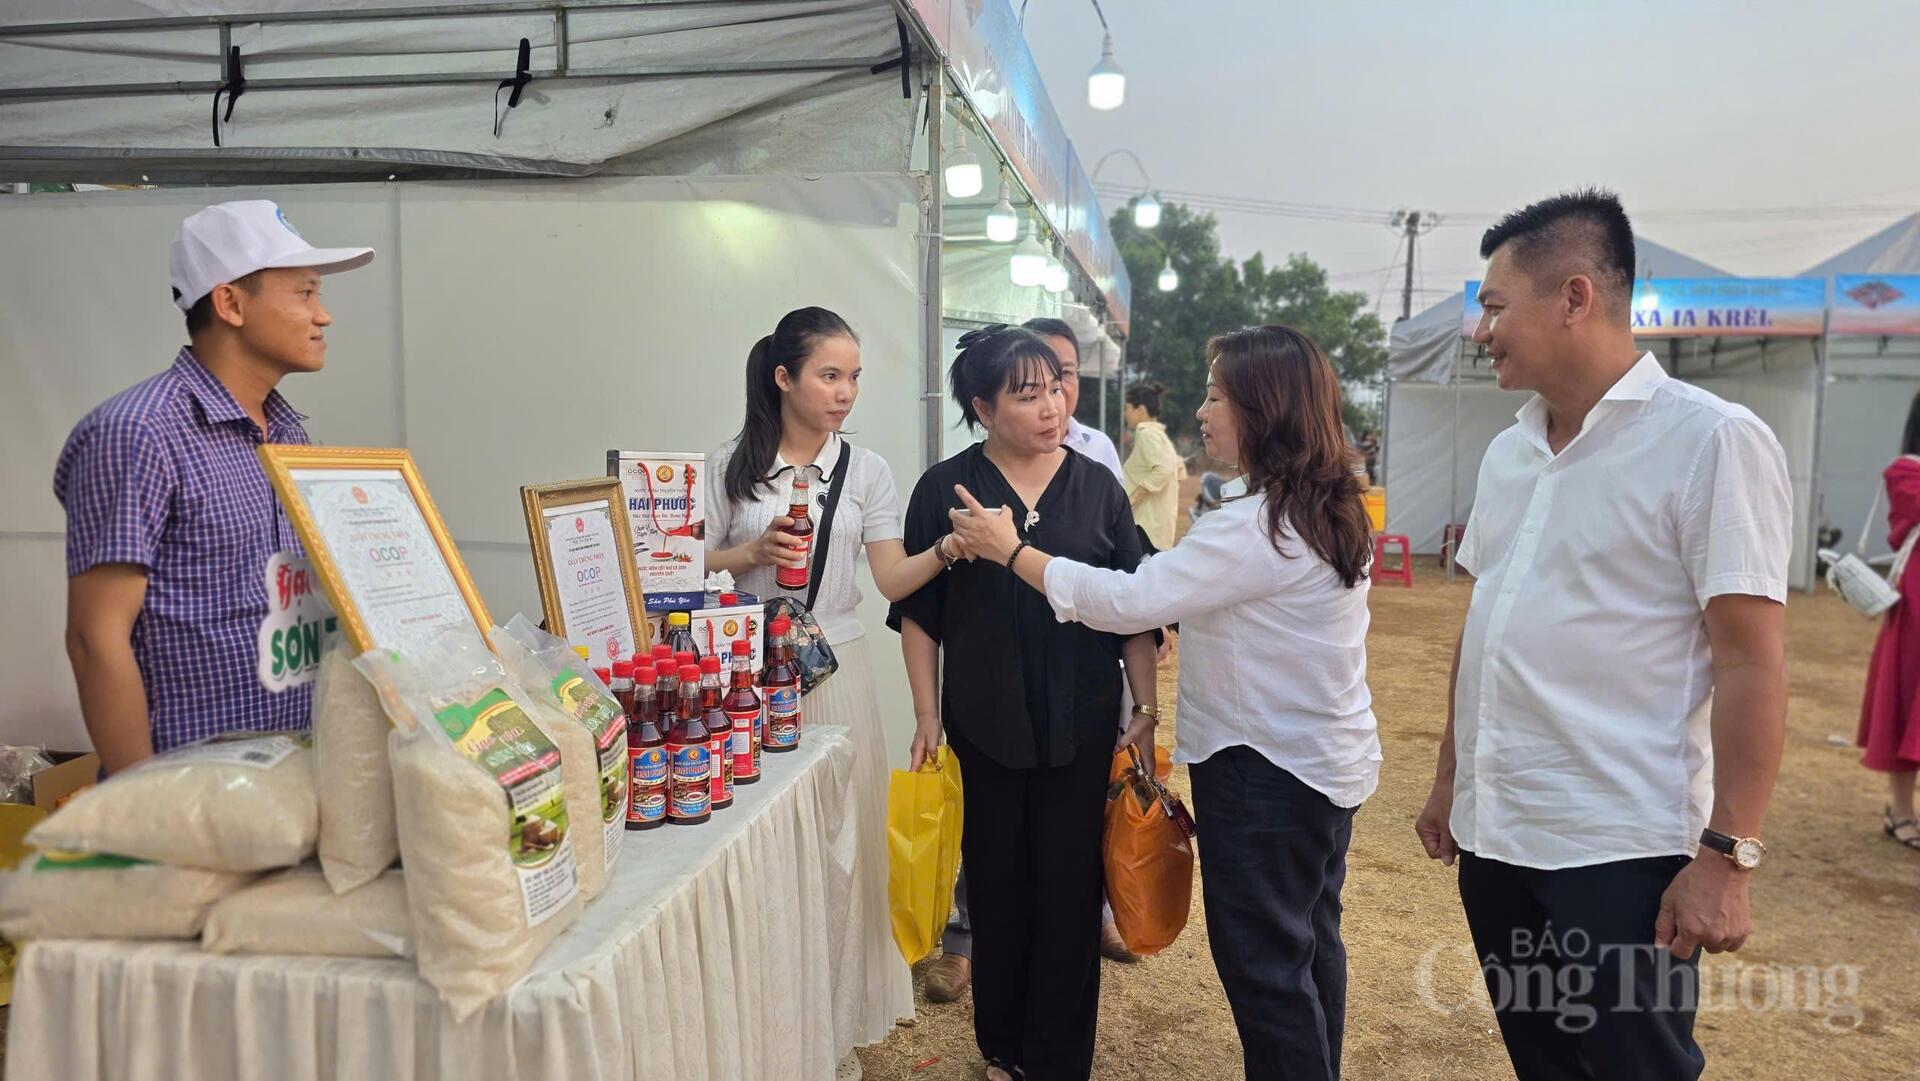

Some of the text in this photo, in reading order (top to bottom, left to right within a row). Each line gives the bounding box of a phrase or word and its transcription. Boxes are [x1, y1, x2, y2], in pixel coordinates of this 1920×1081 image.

[1673, 309, 1696, 327] IA
[369, 546, 407, 562] OCOP
[576, 566, 601, 583] OCOP
[271, 615, 320, 676] SƠN
